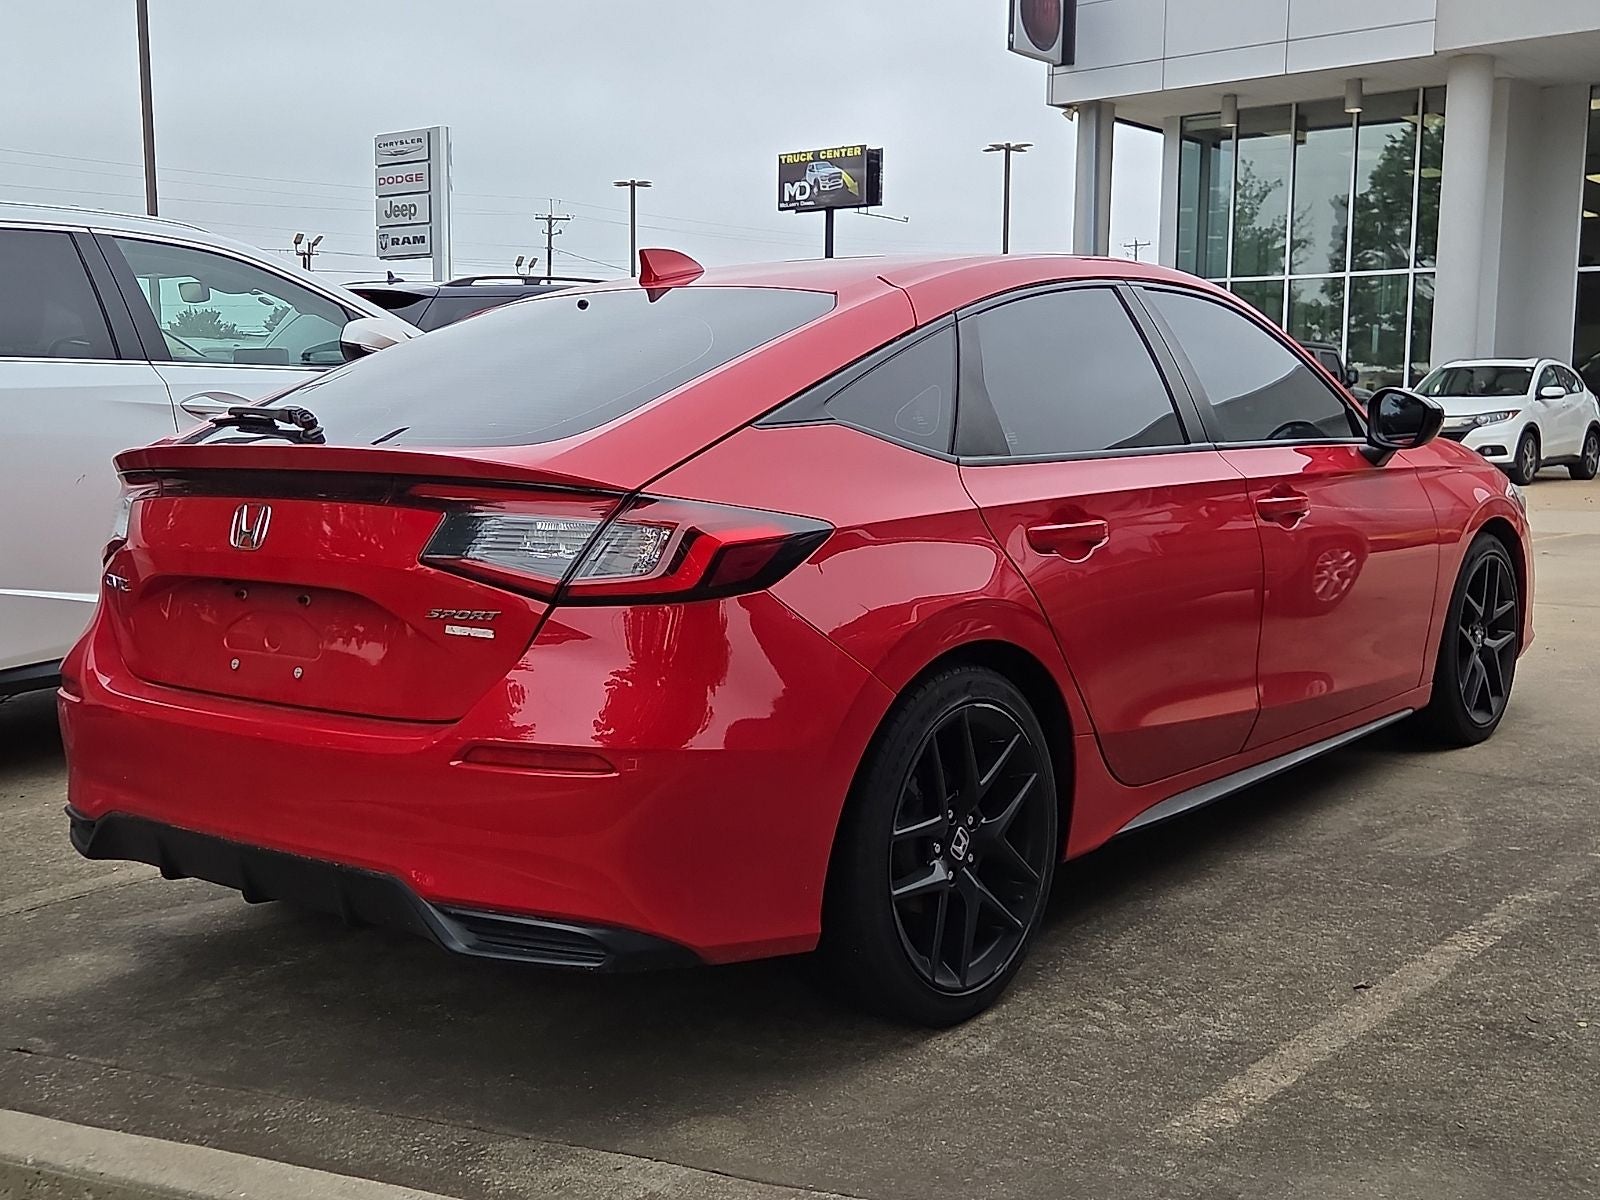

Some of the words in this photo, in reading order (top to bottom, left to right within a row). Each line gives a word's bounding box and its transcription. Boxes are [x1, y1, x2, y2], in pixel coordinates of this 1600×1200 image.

[377, 137, 423, 149] CHRYSLER
[780, 152, 814, 164] TRUCK
[820, 147, 862, 159] CENTER
[378, 172, 425, 187] DODGE
[784, 181, 811, 202] MD
[384, 200, 418, 221] Jeep
[391, 235, 426, 247] RAM
[425, 608, 502, 620] SPORT
